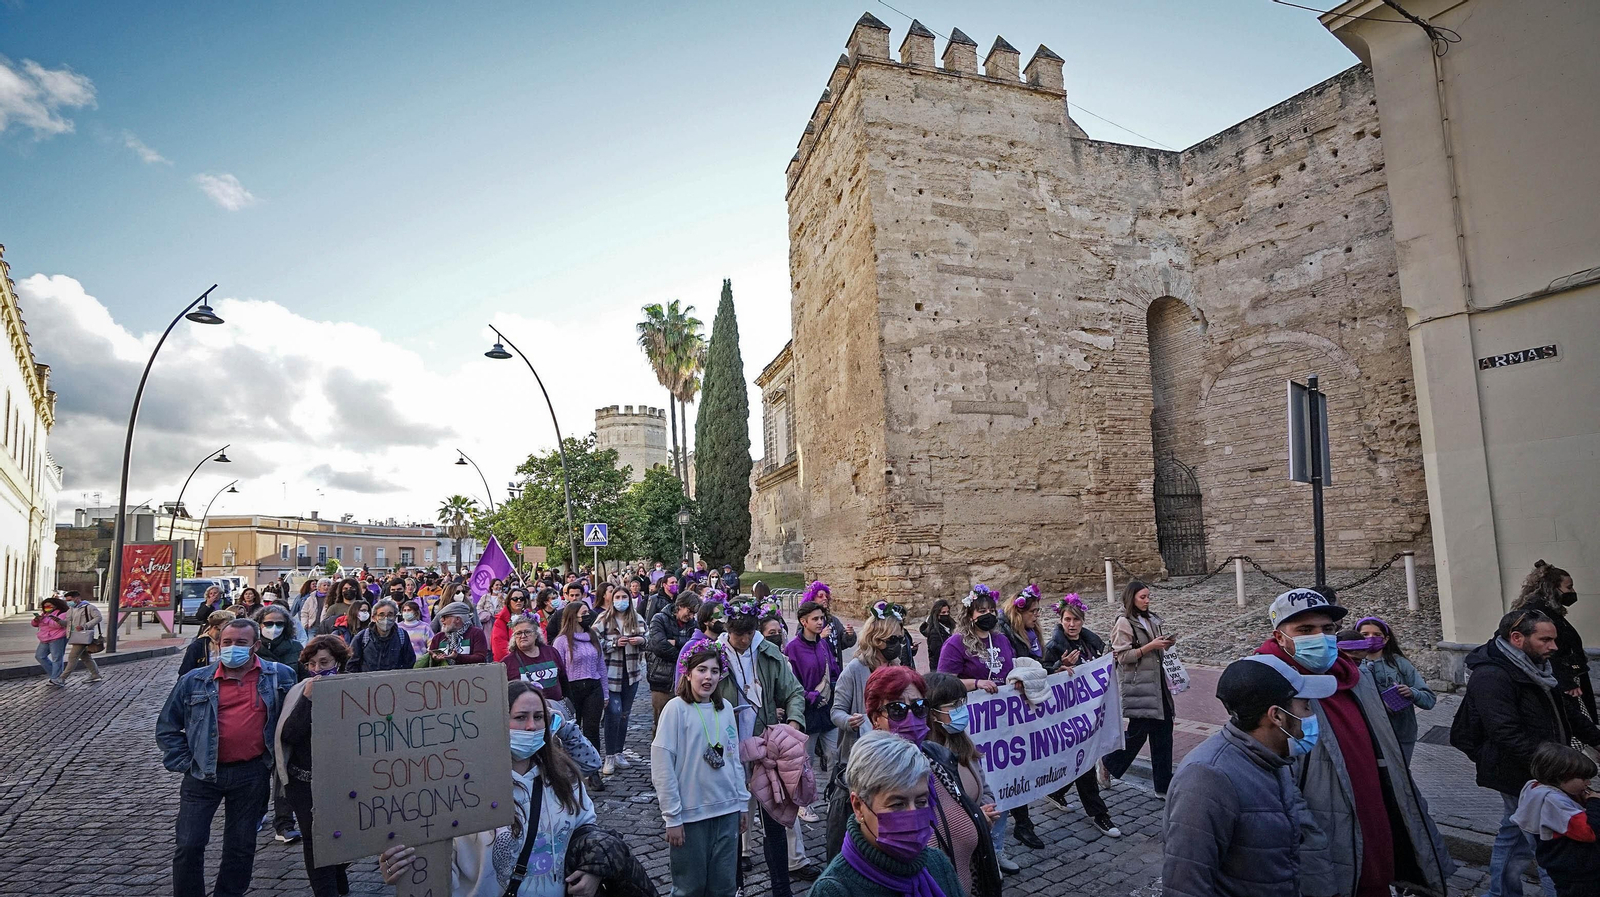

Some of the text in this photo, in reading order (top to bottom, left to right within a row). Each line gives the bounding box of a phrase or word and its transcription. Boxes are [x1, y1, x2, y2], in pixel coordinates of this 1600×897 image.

[1480, 345, 1555, 369] ARMAS
[341, 676, 488, 719] NO SOMOS
[358, 710, 479, 756] PRINCESAS
[1029, 702, 1106, 761] INVISIBLES
[372, 749, 465, 790] SOMOS
[998, 776, 1030, 800] violeta
[358, 781, 481, 831] DRAGONAS
[412, 856, 428, 885] 8
